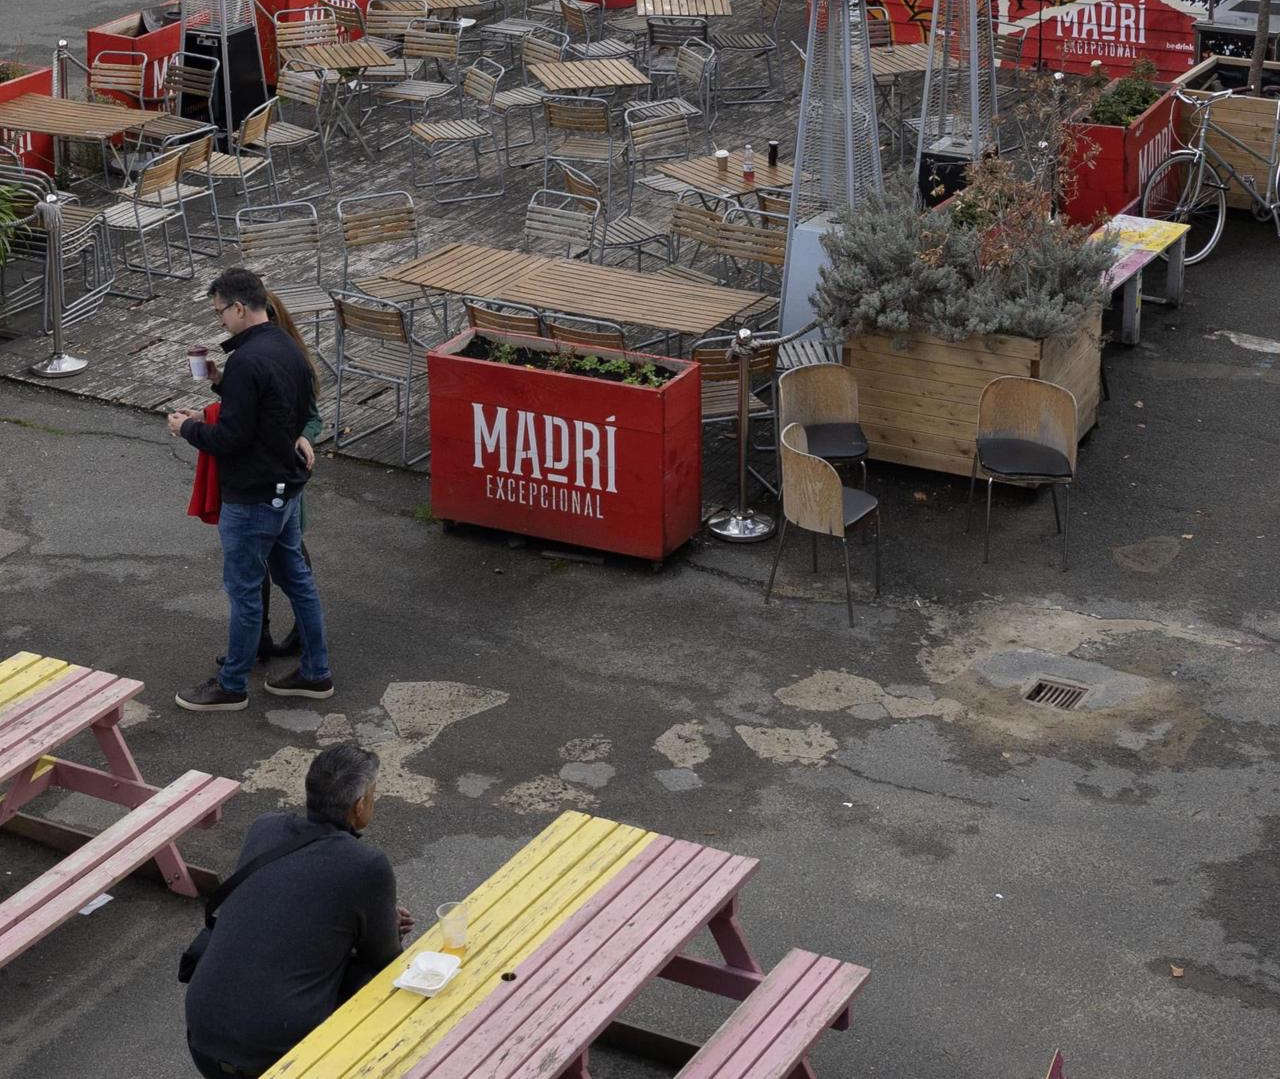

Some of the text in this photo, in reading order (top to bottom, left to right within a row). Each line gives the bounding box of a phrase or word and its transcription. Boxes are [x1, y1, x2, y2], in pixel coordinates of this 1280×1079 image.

[1063, 39, 1138, 59] EXCEPCIONAL
[471, 402, 618, 494] MADRÍ
[486, 474, 604, 519] EXCEPCIONAL
